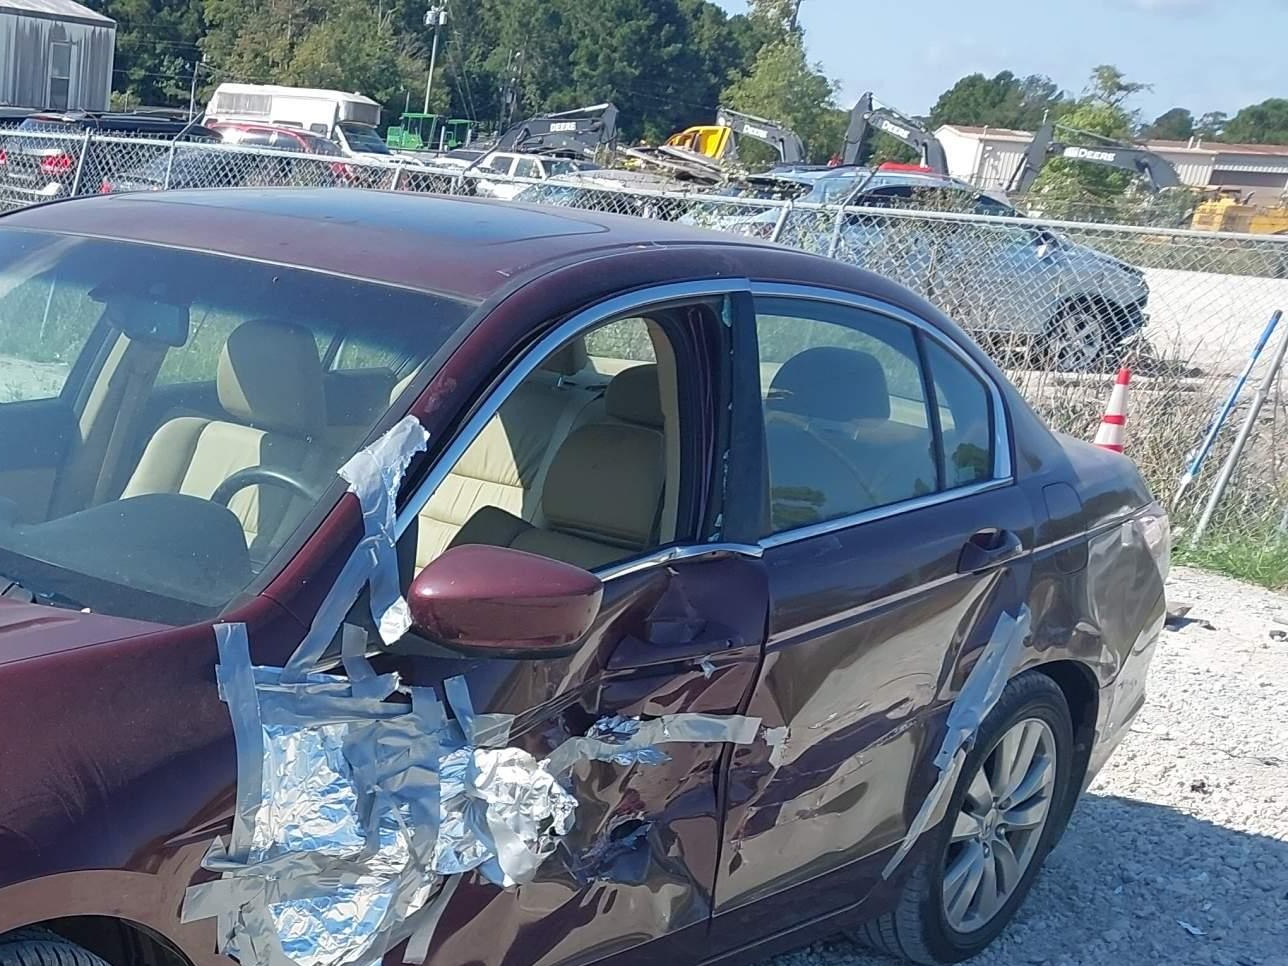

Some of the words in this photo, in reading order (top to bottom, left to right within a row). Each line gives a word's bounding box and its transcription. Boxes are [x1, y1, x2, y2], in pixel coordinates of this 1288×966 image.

[549, 121, 577, 133] DEERE
[742, 124, 769, 139] DEERE
[882, 119, 911, 139] DEERE
[1078, 148, 1116, 162] DEERE
